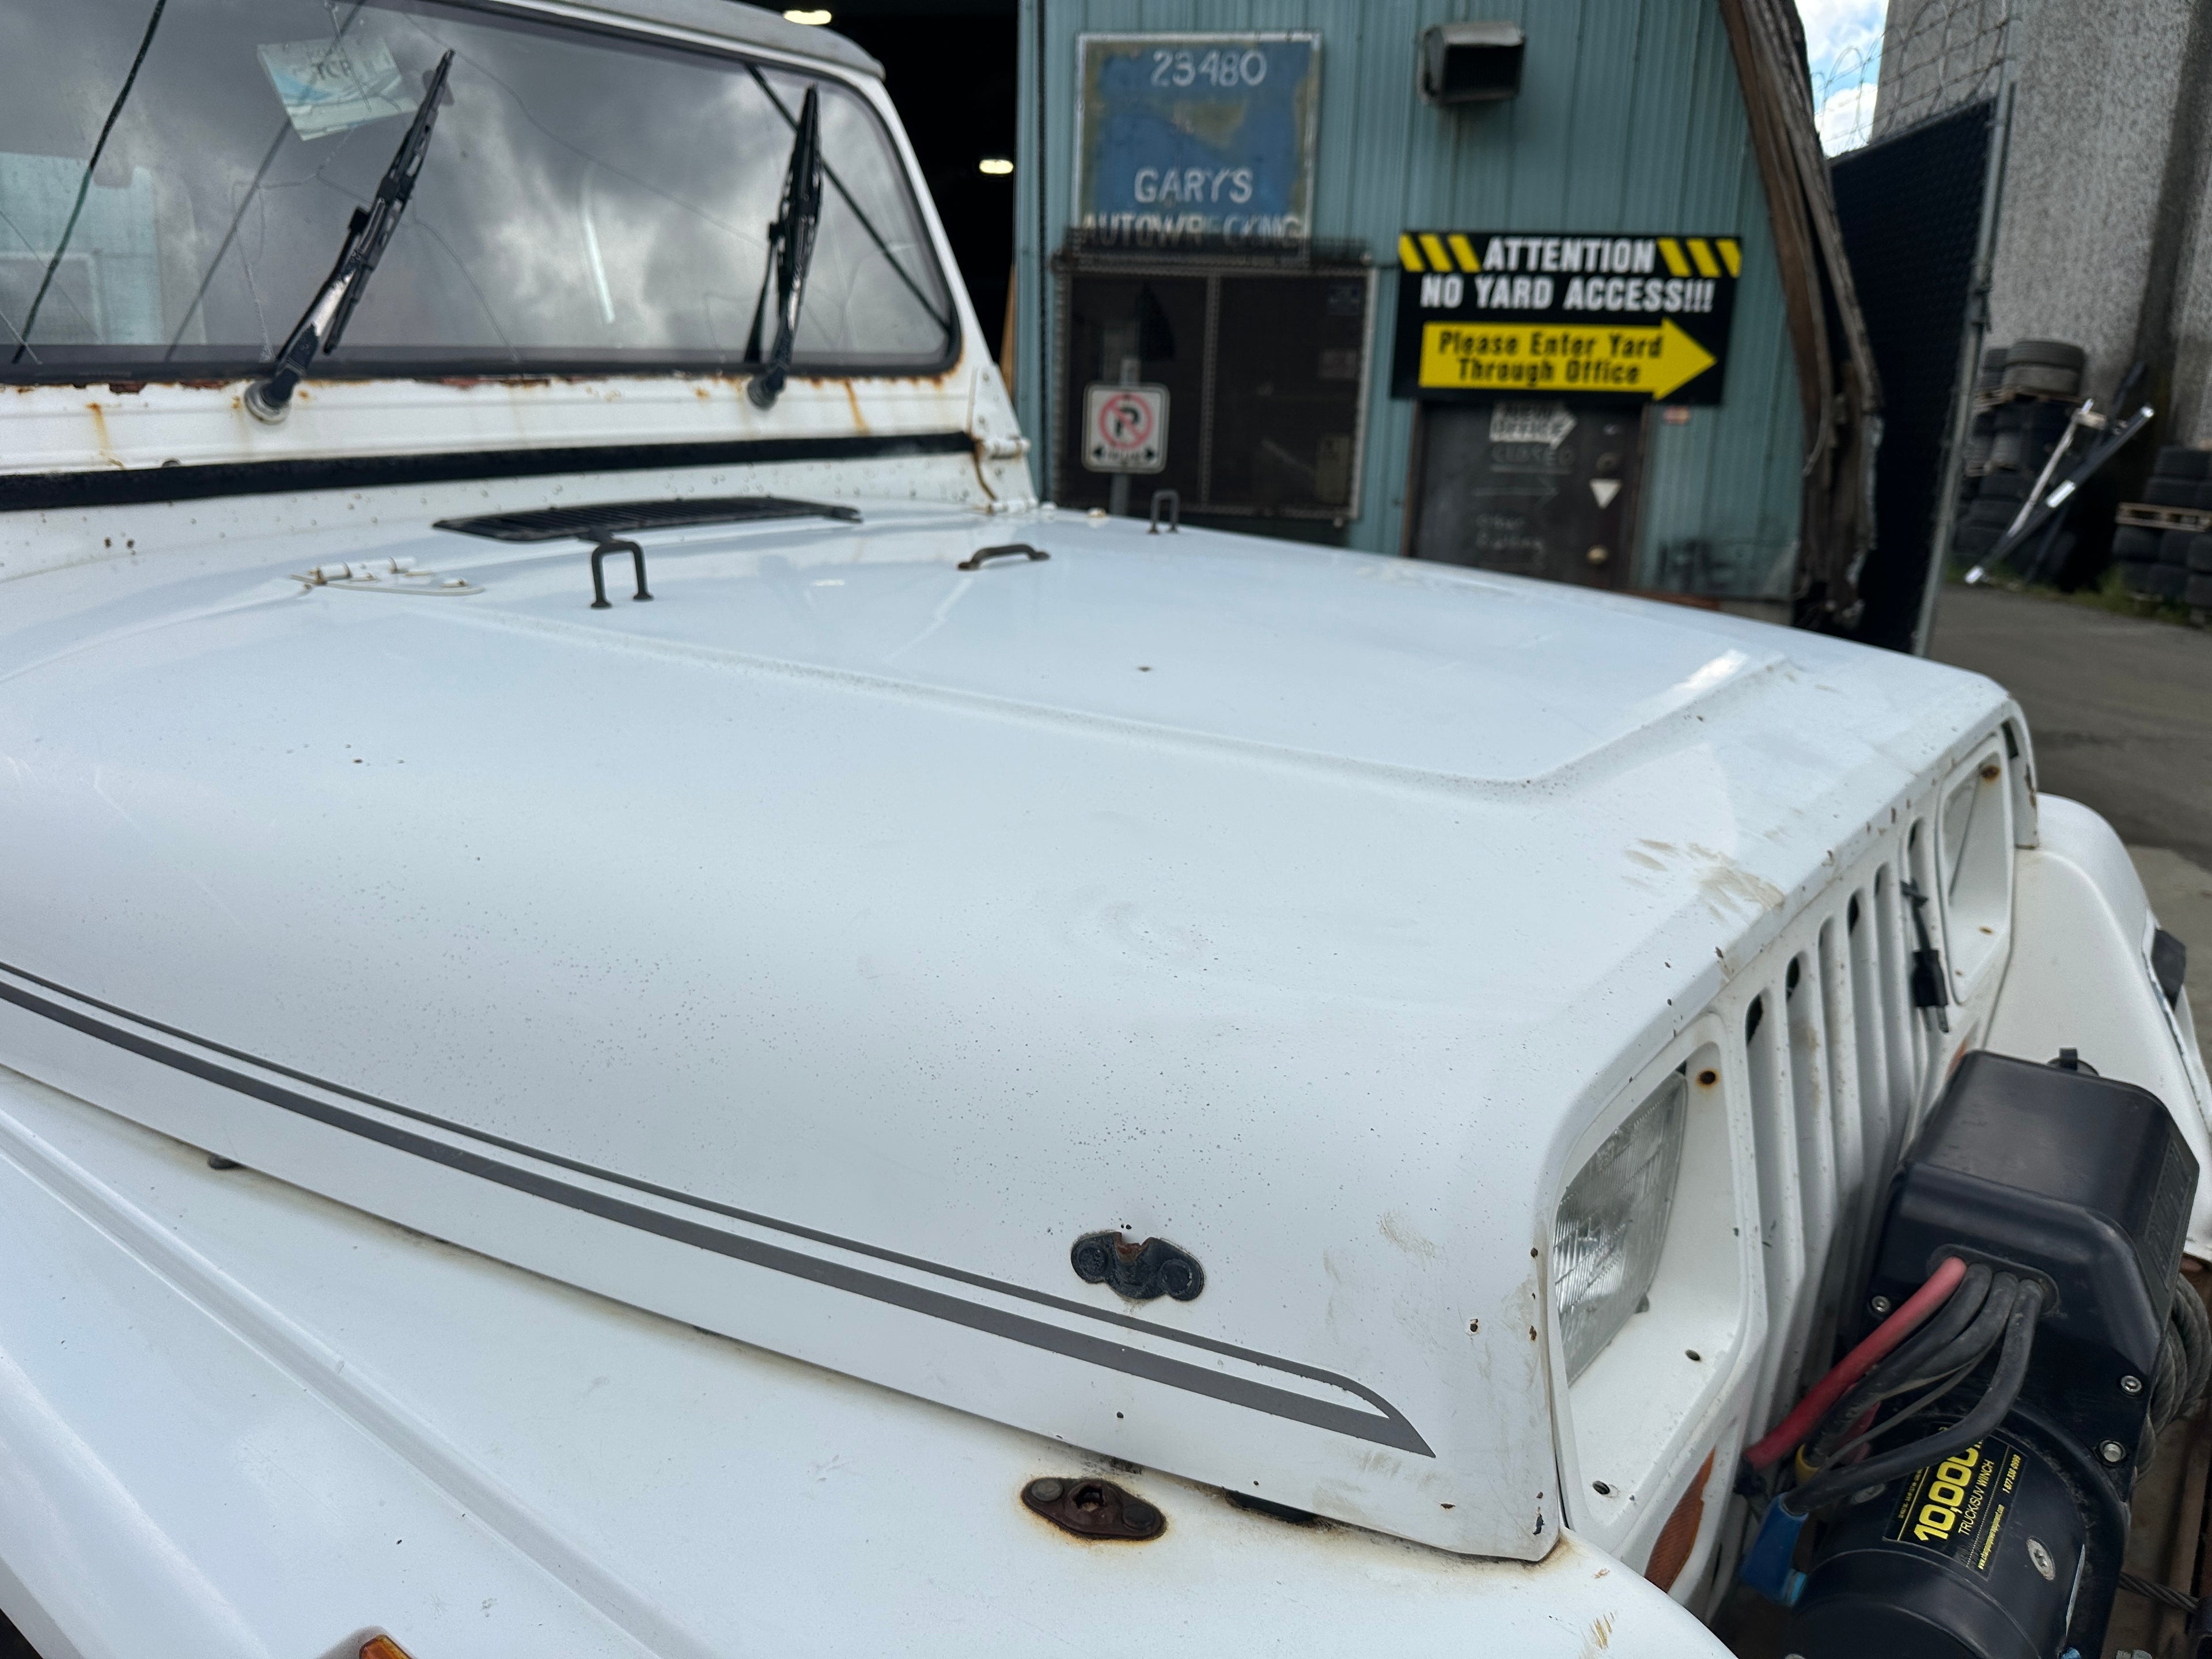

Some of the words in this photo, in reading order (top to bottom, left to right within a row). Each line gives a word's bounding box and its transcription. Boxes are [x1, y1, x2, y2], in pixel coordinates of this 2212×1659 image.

[1151, 49, 1267, 86] 23480
[1483, 236, 1657, 274] ATTENTION
[1421, 273, 1464, 309] NO
[1475, 275, 1554, 310] YARD
[1562, 278, 1716, 313] ACCESS!!!
[1440, 330, 1519, 356] Please
[1529, 331, 1596, 358] Enter
[1609, 332, 1662, 359] Yard
[1460, 357, 1554, 387] Through
[1565, 359, 1641, 385] Office
[1958, 1485, 1985, 1536] TRUCK/SUV
[1976, 1459, 1995, 1487] WINCH
